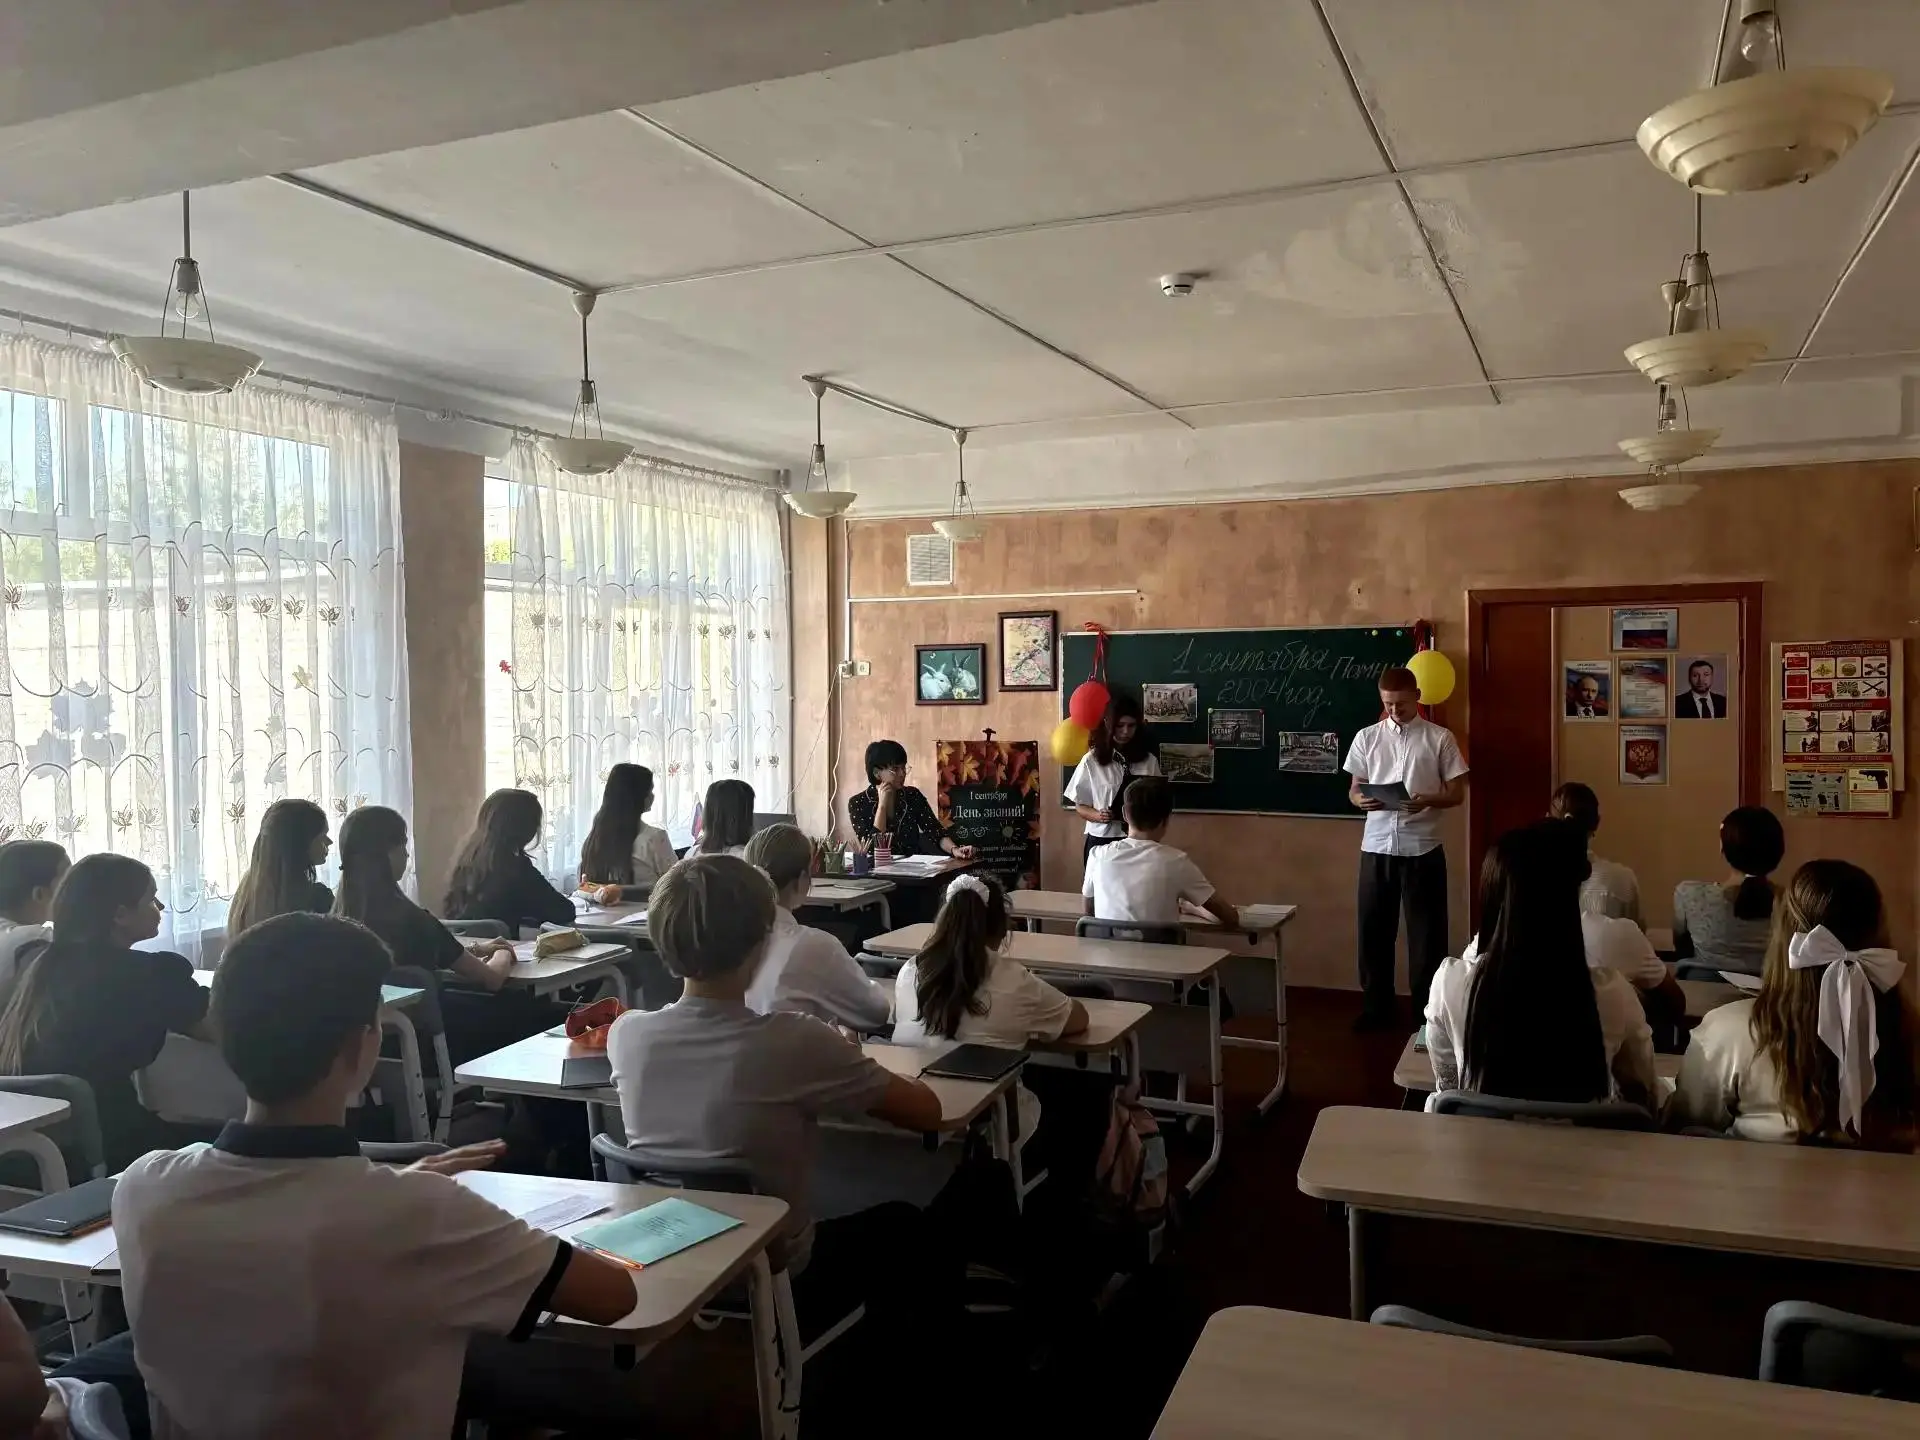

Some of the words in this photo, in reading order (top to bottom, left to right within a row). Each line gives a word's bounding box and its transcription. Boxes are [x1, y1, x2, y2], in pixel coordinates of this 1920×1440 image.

[1171, 637, 1195, 674] 1
[1217, 676, 1286, 705] 2004
[974, 791, 1008, 801] сентября
[953, 805, 982, 819] День
[983, 804, 1025, 818] знаний!
